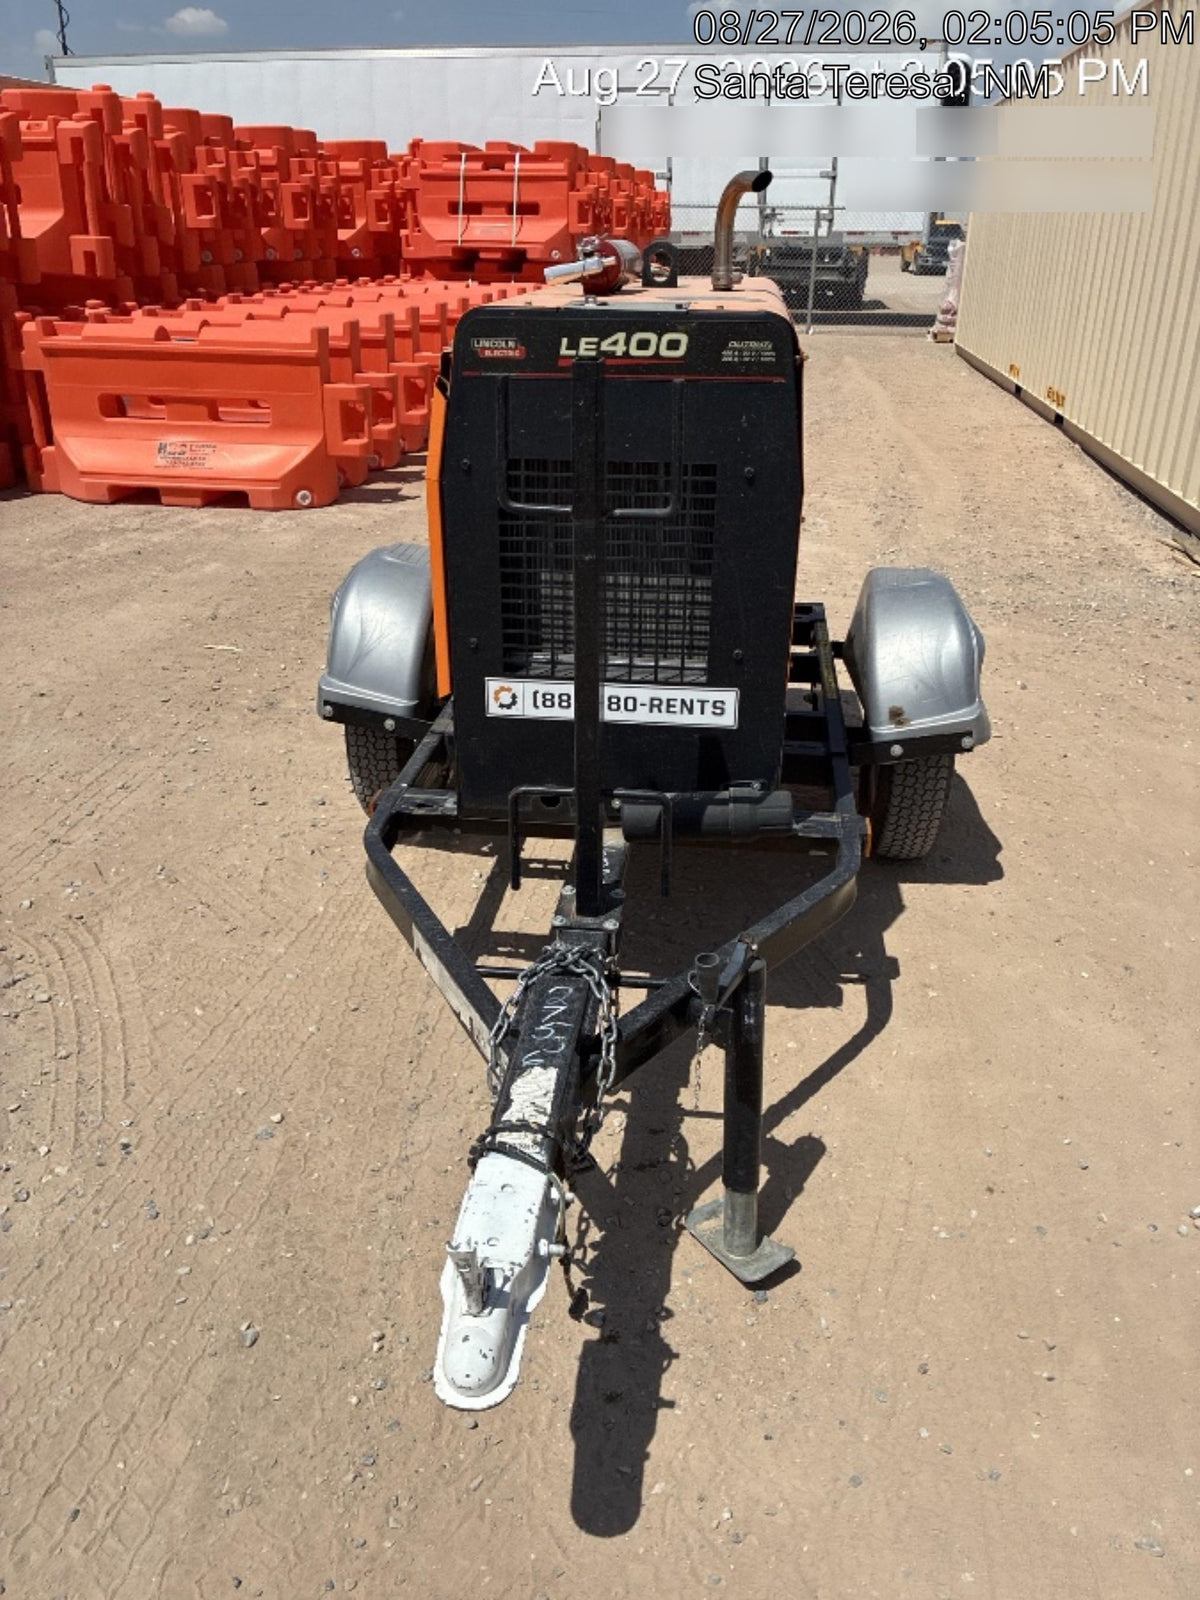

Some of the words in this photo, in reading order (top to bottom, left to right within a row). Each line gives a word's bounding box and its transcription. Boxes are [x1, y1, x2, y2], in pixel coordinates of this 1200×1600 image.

[474, 339, 516, 348] LINCOLN
[559, 331, 689, 358] LE400
[532, 690, 572, 709] (88
[607, 695, 726, 716] 80-RENTS
